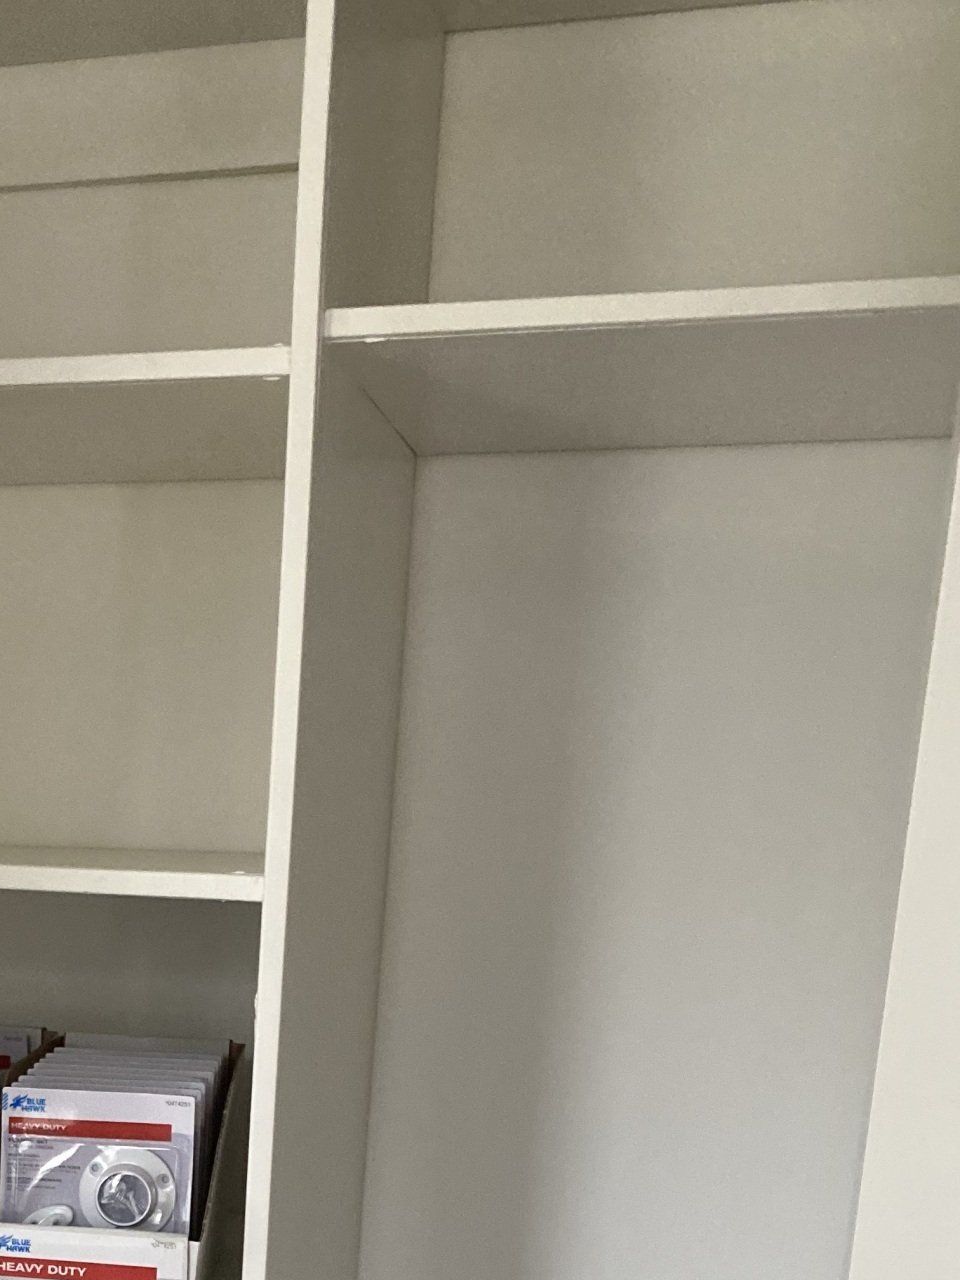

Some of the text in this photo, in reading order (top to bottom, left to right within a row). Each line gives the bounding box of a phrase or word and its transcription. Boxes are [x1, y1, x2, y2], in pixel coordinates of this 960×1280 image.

[11, 1122, 66, 1131] HEAVY DUTY
[12, 1238, 31, 1246] BLUE
[6, 1245, 31, 1253] HAWK
[47, 1264, 87, 1277] DUTY
